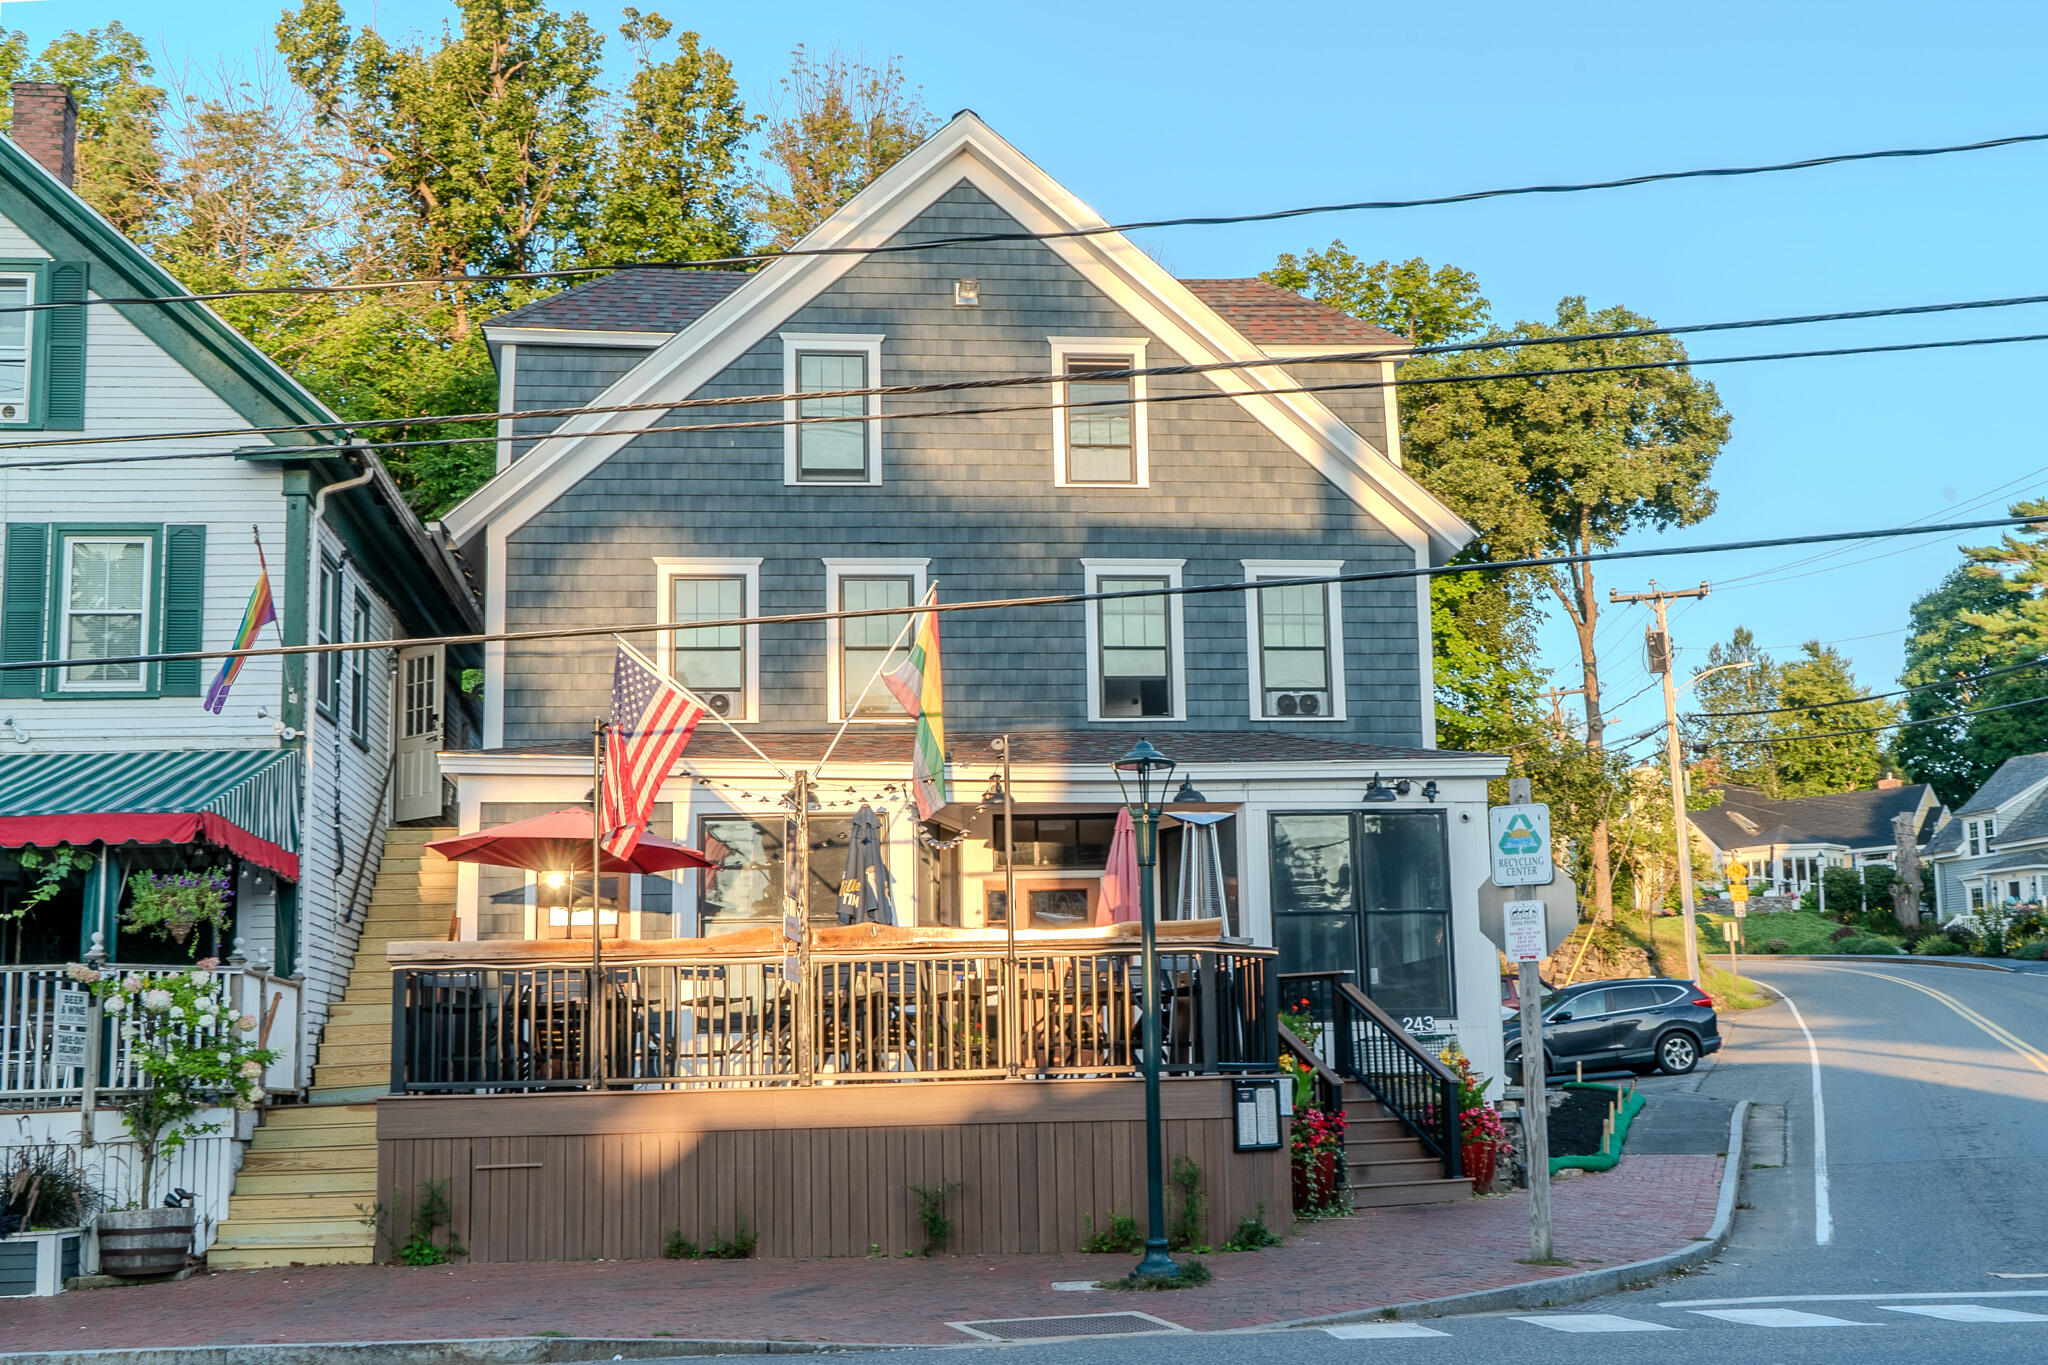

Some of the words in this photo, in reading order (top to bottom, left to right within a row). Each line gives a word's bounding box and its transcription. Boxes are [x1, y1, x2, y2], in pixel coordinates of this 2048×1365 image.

[1499, 856, 1544, 868] RECYCLING
[1506, 866, 1537, 876] CENTER
[65, 995, 84, 1004] BEER
[68, 1005, 86, 1016] WINE
[1402, 1016, 1434, 1031] 243
[58, 1034, 86, 1045] TAKE-OUT
